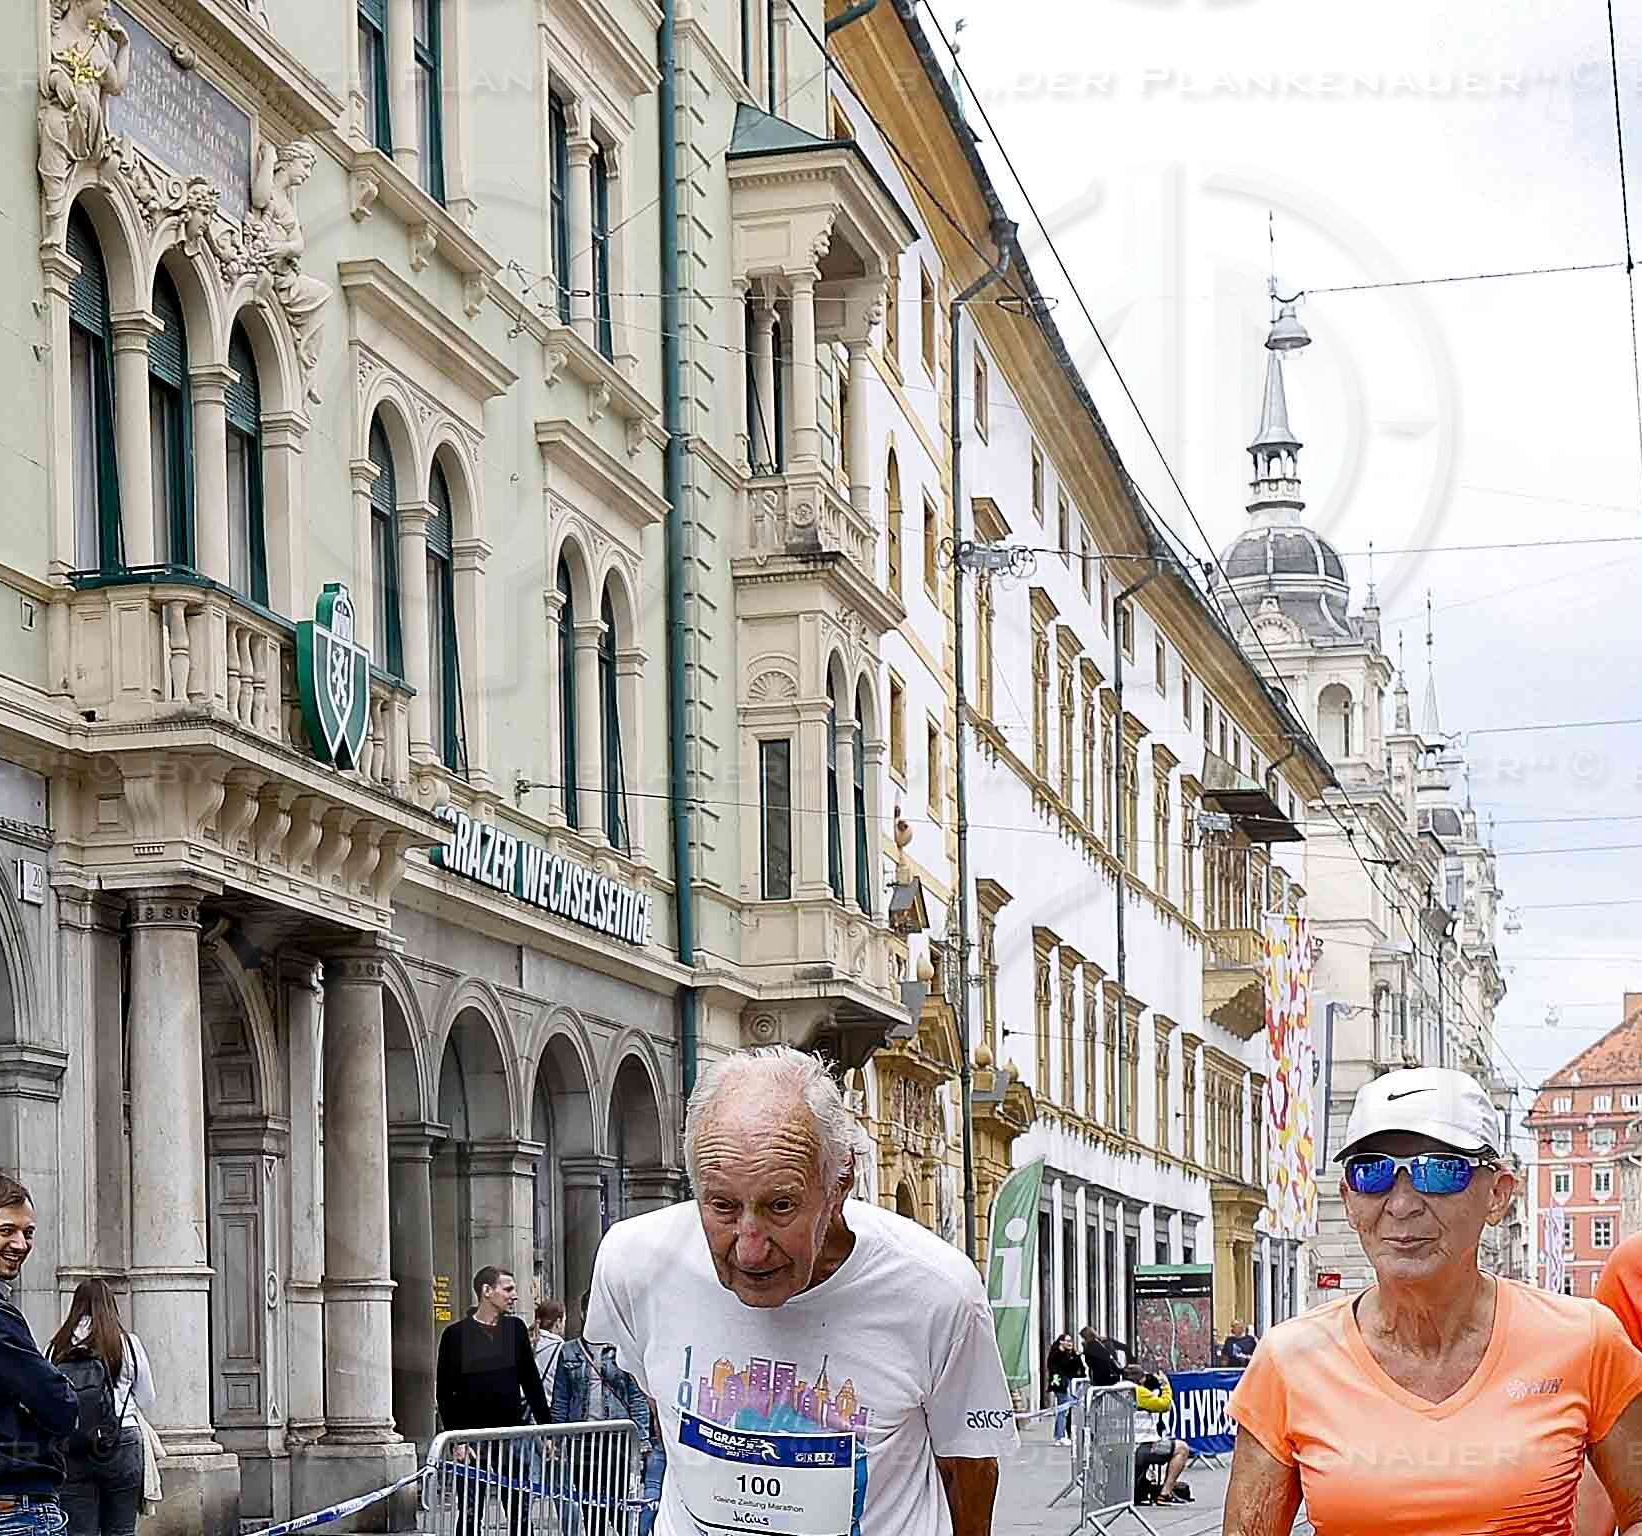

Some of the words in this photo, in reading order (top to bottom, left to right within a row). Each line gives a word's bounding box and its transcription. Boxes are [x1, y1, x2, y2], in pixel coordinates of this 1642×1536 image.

[521, 840, 653, 945] WECHSELSEITIGE
[713, 1431, 746, 1447] GRAZ
[737, 1474, 781, 1497] 100
[738, 1498, 766, 1511] Zeitung
[767, 1502, 804, 1514] Marathon
[732, 1510, 770, 1526] Julius
